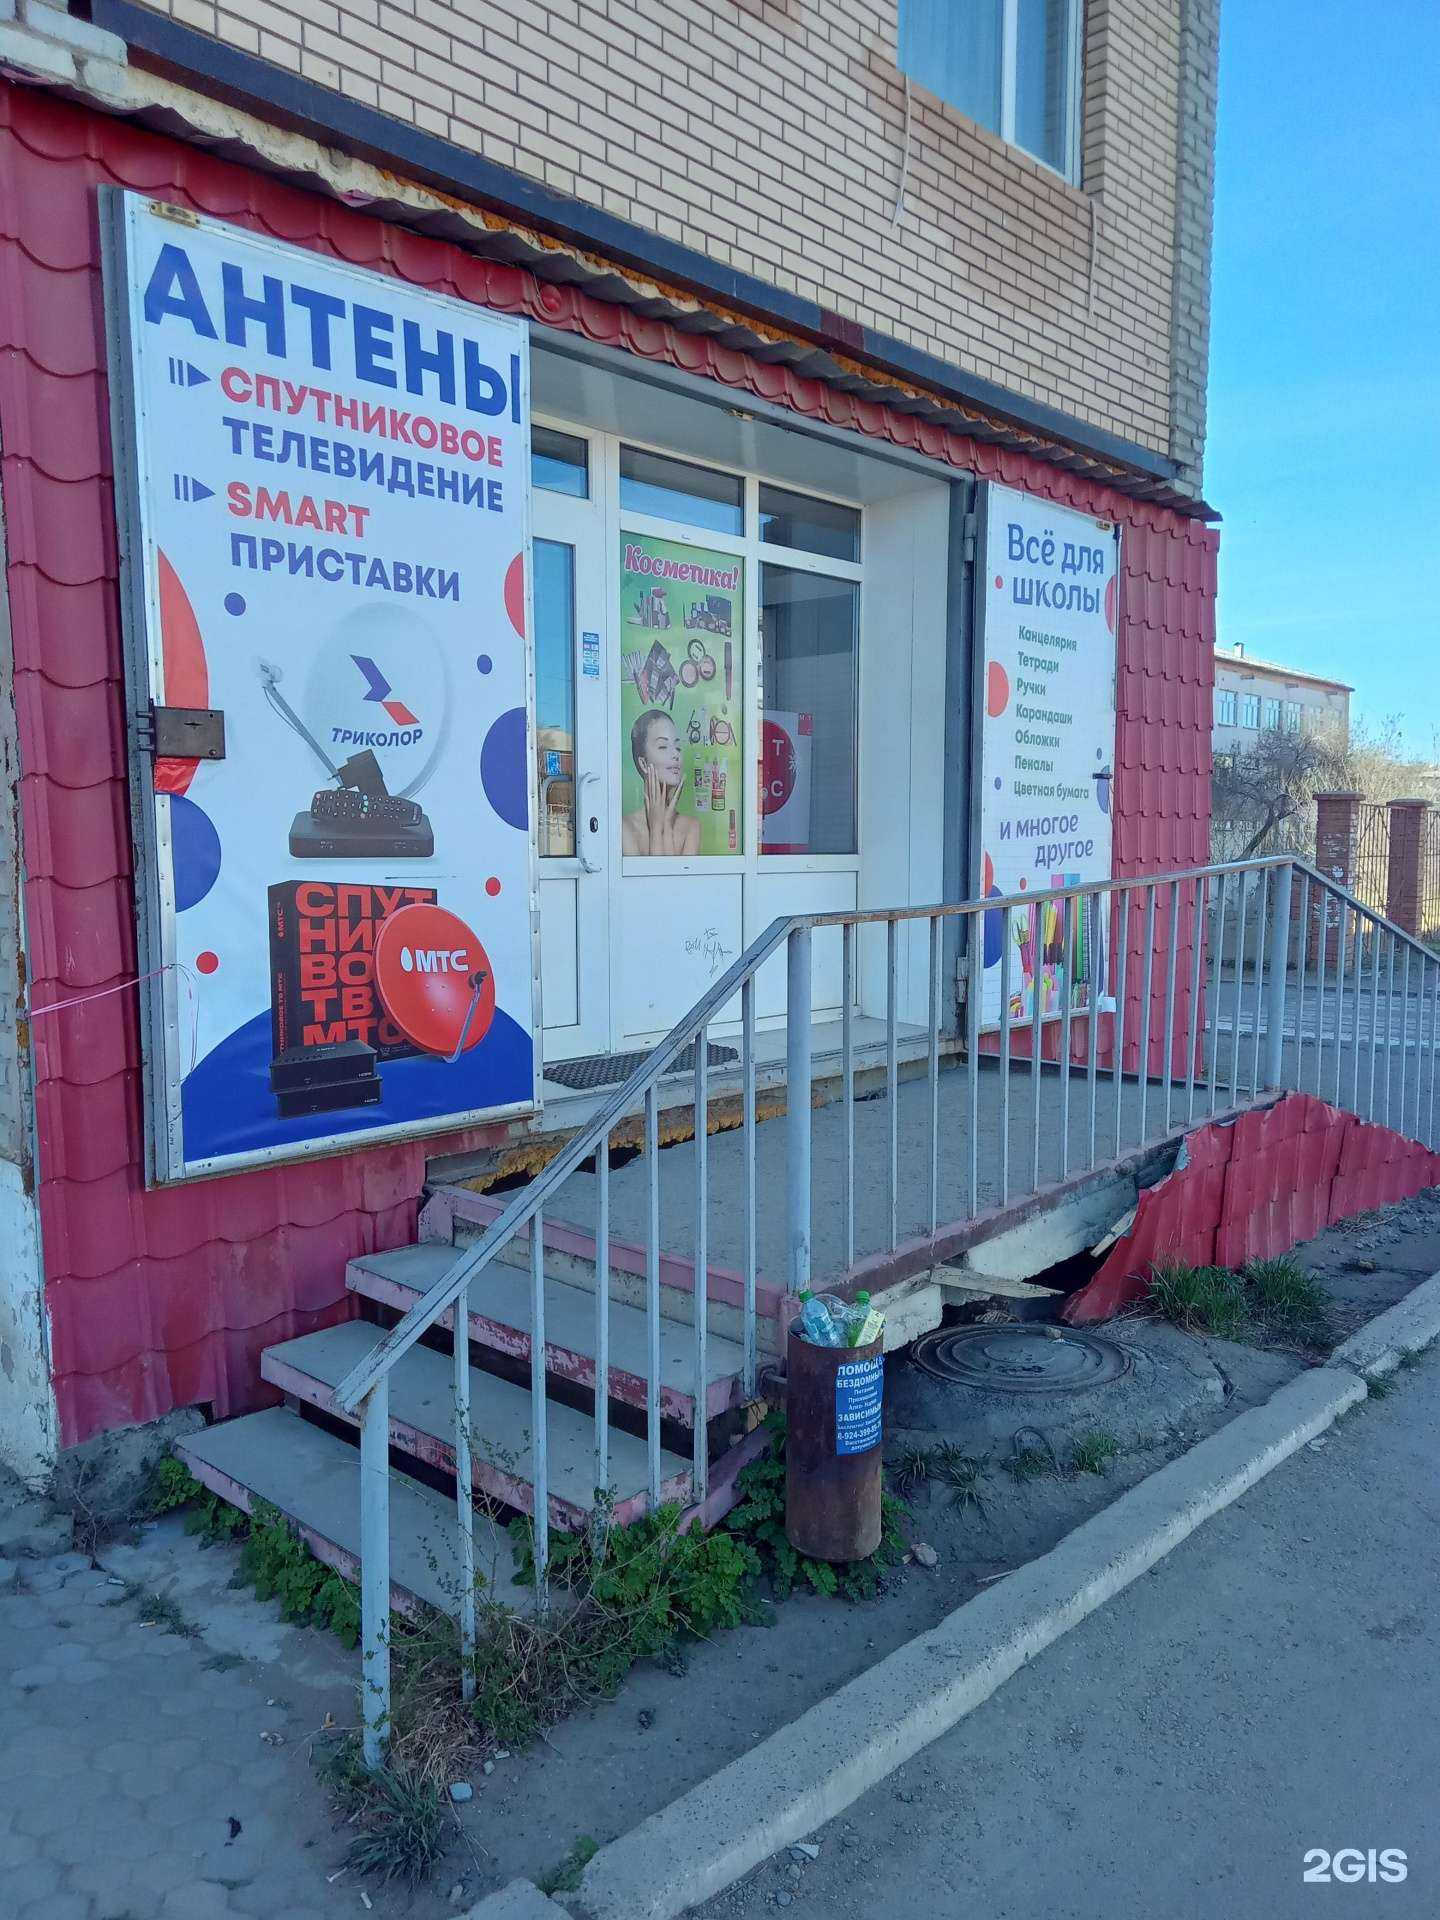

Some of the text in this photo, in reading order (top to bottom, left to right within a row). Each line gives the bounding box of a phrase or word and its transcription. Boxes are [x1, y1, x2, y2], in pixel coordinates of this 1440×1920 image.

[144, 243, 521, 424] АНТЕНЫ
[219, 366, 503, 467] СПУТНИКОВОЕ
[222, 416, 504, 513] ТЕЛЕВИДЕНИЕ
[227, 481, 370, 538] SMART
[1007, 523, 1104, 575] Всё для
[230, 532, 460, 601] ПРИСТАВКИ
[625, 544, 739, 591] Косметика!
[1018, 625, 1077, 651] Канцелярия
[1017, 651, 1059, 673] Тетради
[1017, 677, 1046, 696] Ручки
[1016, 703, 1073, 724] Карандаши
[332, 727, 423, 747] ТРИКОЛОР
[1015, 729, 1060, 748] Обложки
[1014, 755, 1054, 772] Пеналы
[1014, 781, 1089, 801] Цветная бумага
[1000, 814, 1079, 840] и многое
[1035, 839, 1094, 869] другое
[415, 949, 469, 973] МТС
[302, 985, 374, 1023] ТВ
